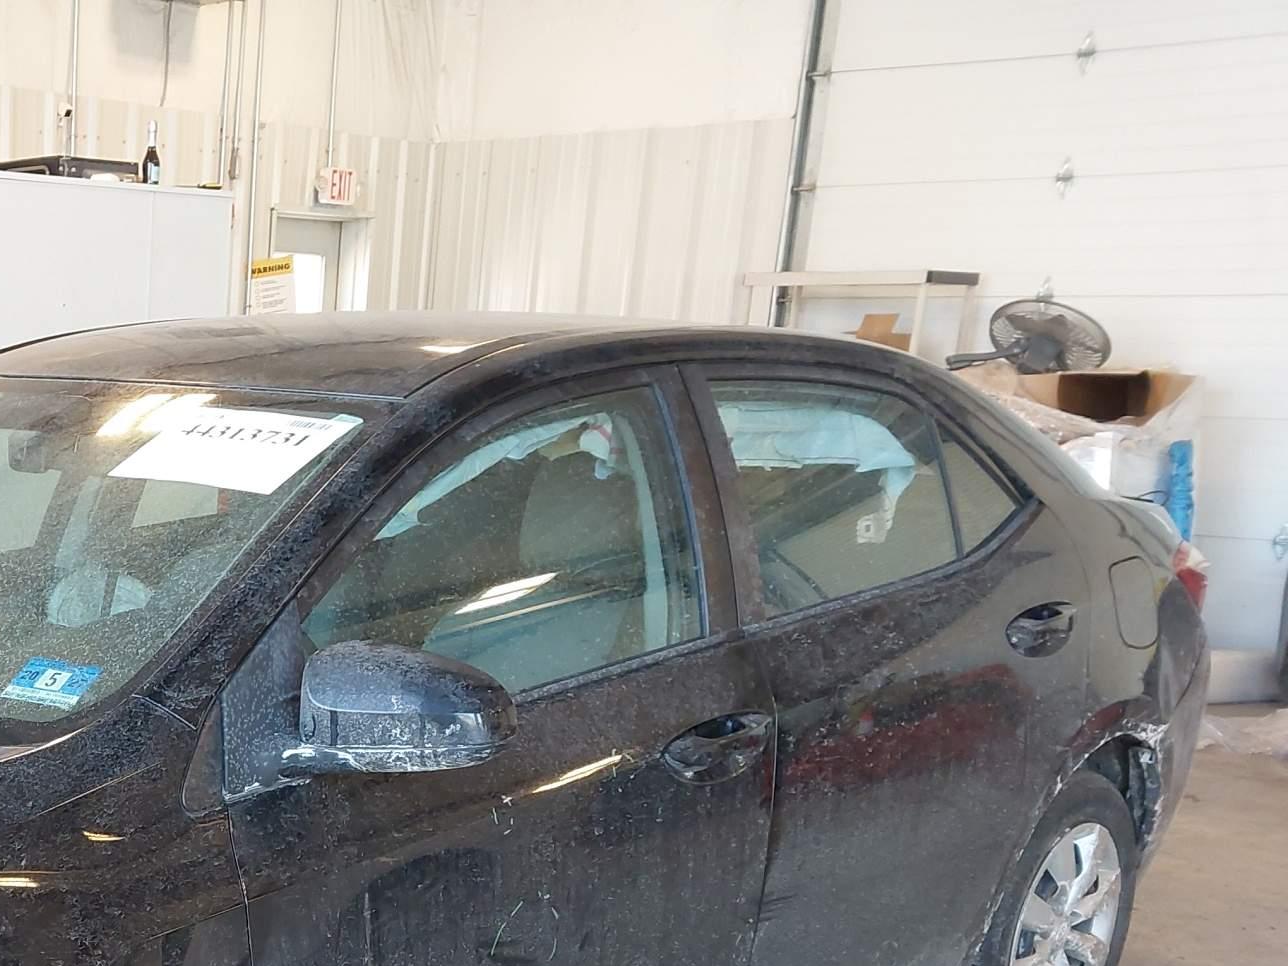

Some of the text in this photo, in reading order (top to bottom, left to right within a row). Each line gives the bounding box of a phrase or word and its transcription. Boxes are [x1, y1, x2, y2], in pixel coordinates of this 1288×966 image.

[330, 169, 353, 201] EXIT
[180, 423, 311, 447] 44313731
[20, 670, 40, 682] 20
[44, 672, 62, 687] 5
